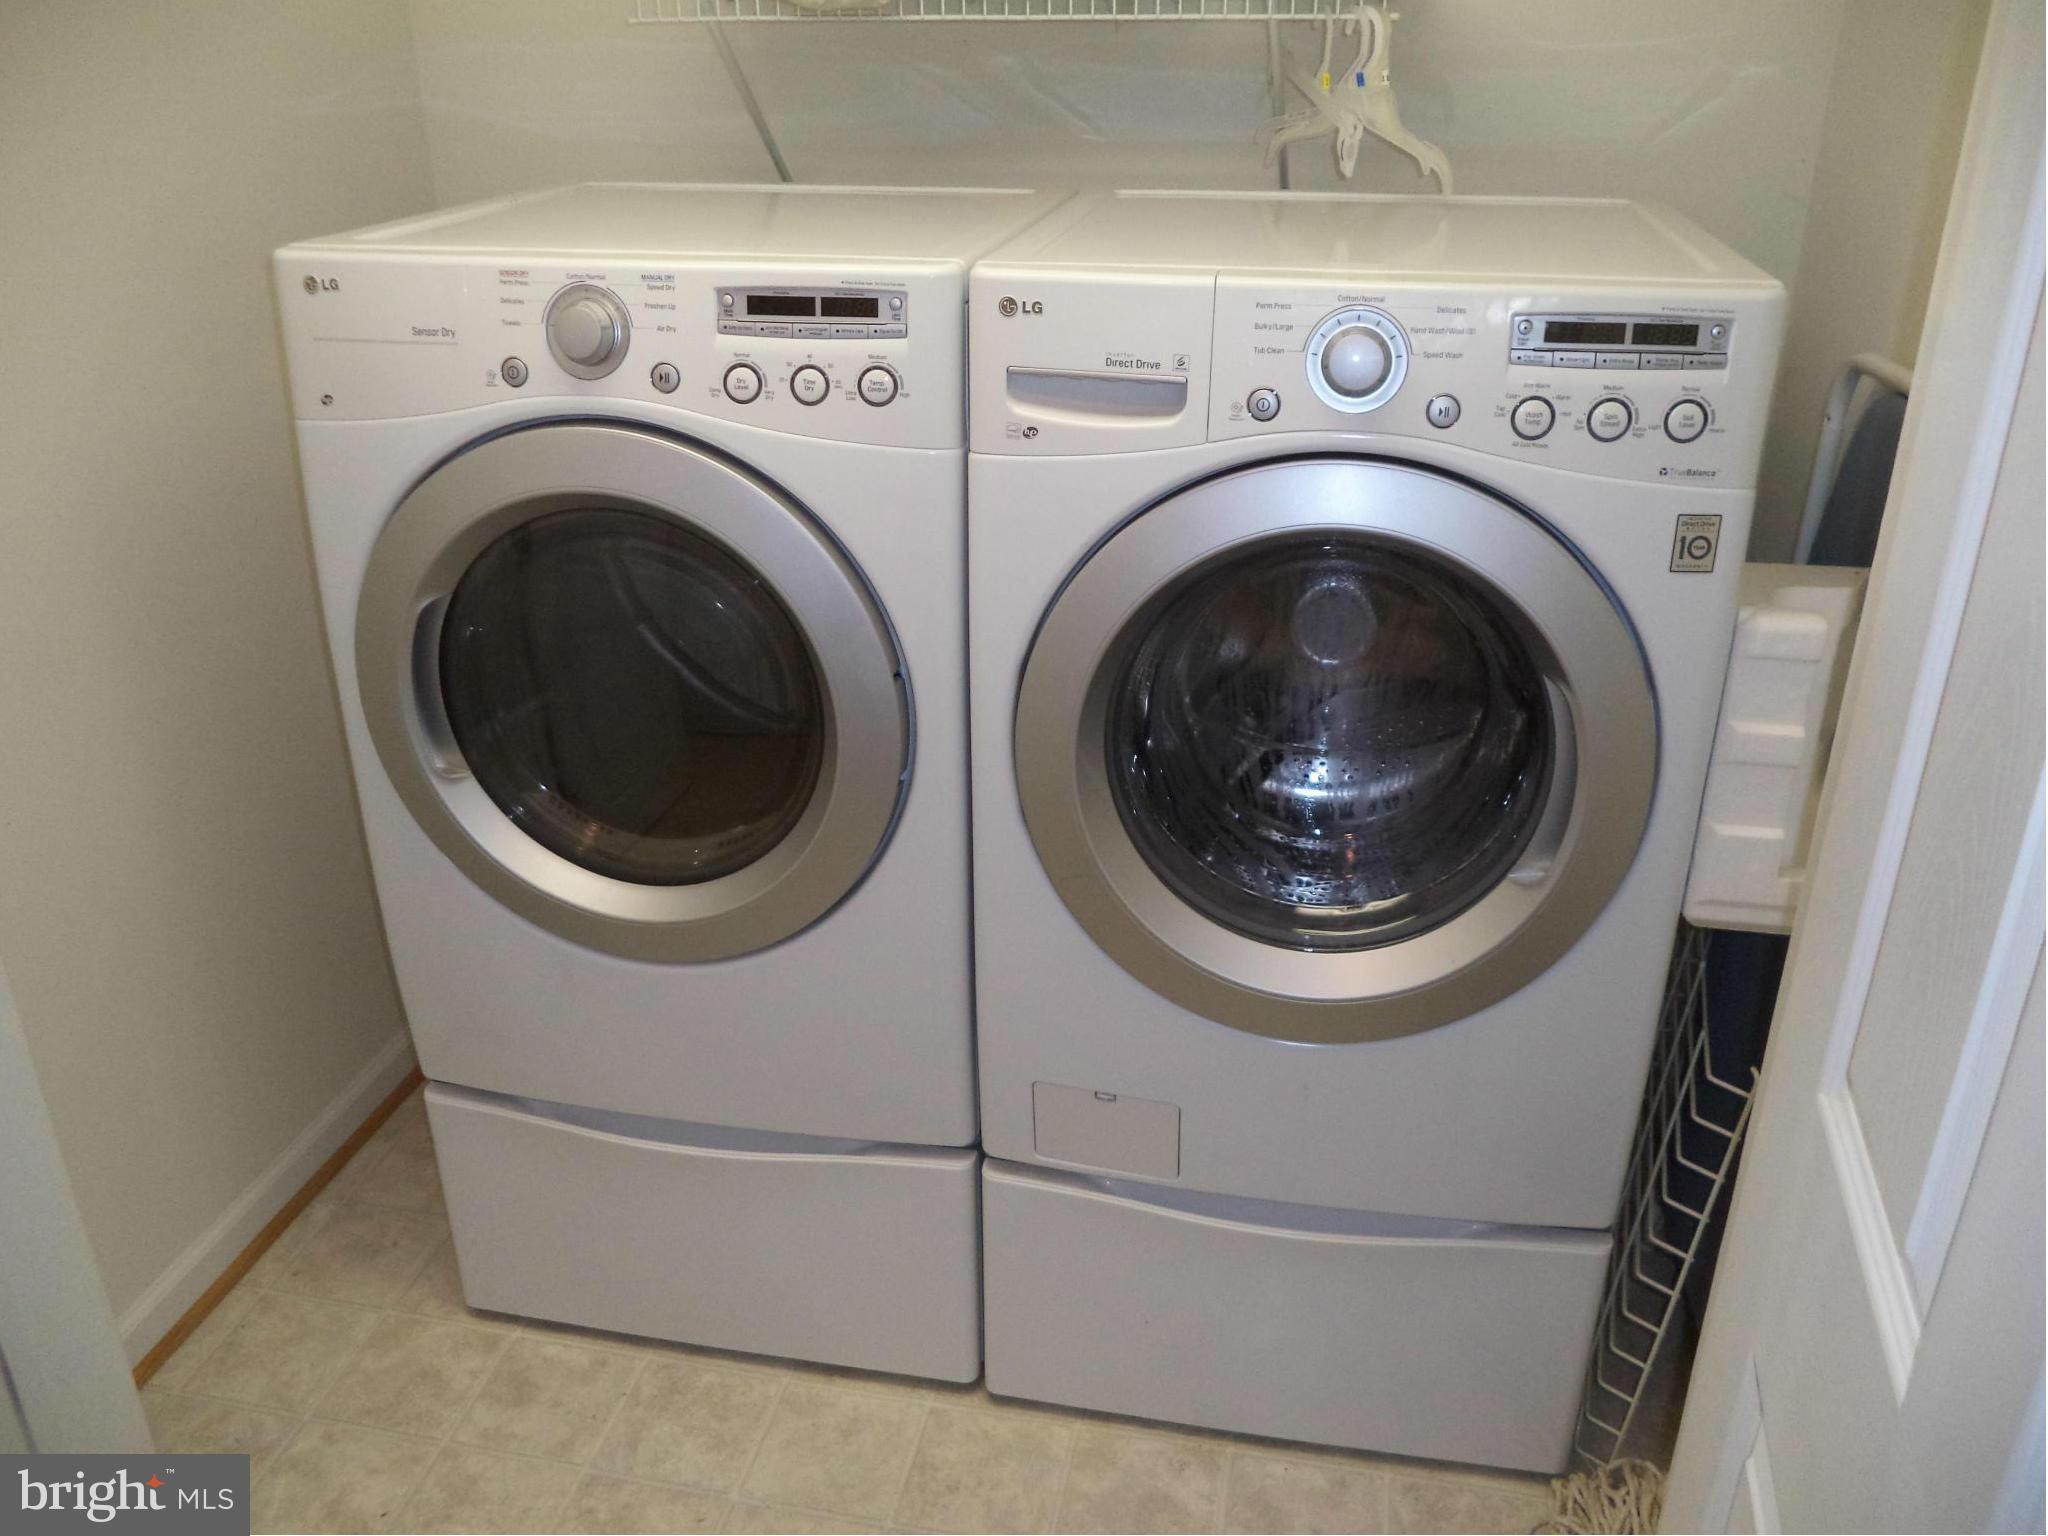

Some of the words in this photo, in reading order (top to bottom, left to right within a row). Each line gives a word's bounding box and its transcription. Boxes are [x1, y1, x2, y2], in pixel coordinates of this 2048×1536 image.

[321, 278, 340, 291] LG
[665, 285, 676, 293] Dry
[1337, 295, 1386, 303] Cotton/Normal
[1022, 301, 1043, 314] LG
[1256, 302, 1273, 310] Perm
[1436, 306, 1467, 314] Delicates
[666, 326, 677, 334] Dry
[1254, 322, 1294, 331] Bulky/Large
[1410, 327, 1427, 335] Hand
[411, 326, 439, 337] Sensor
[441, 327, 456, 338] Dry
[1423, 351, 1443, 360] Speed
[1105, 357, 1134, 369] Direct
[1136, 359, 1161, 370] Drive
[1678, 535, 1713, 560] 10
